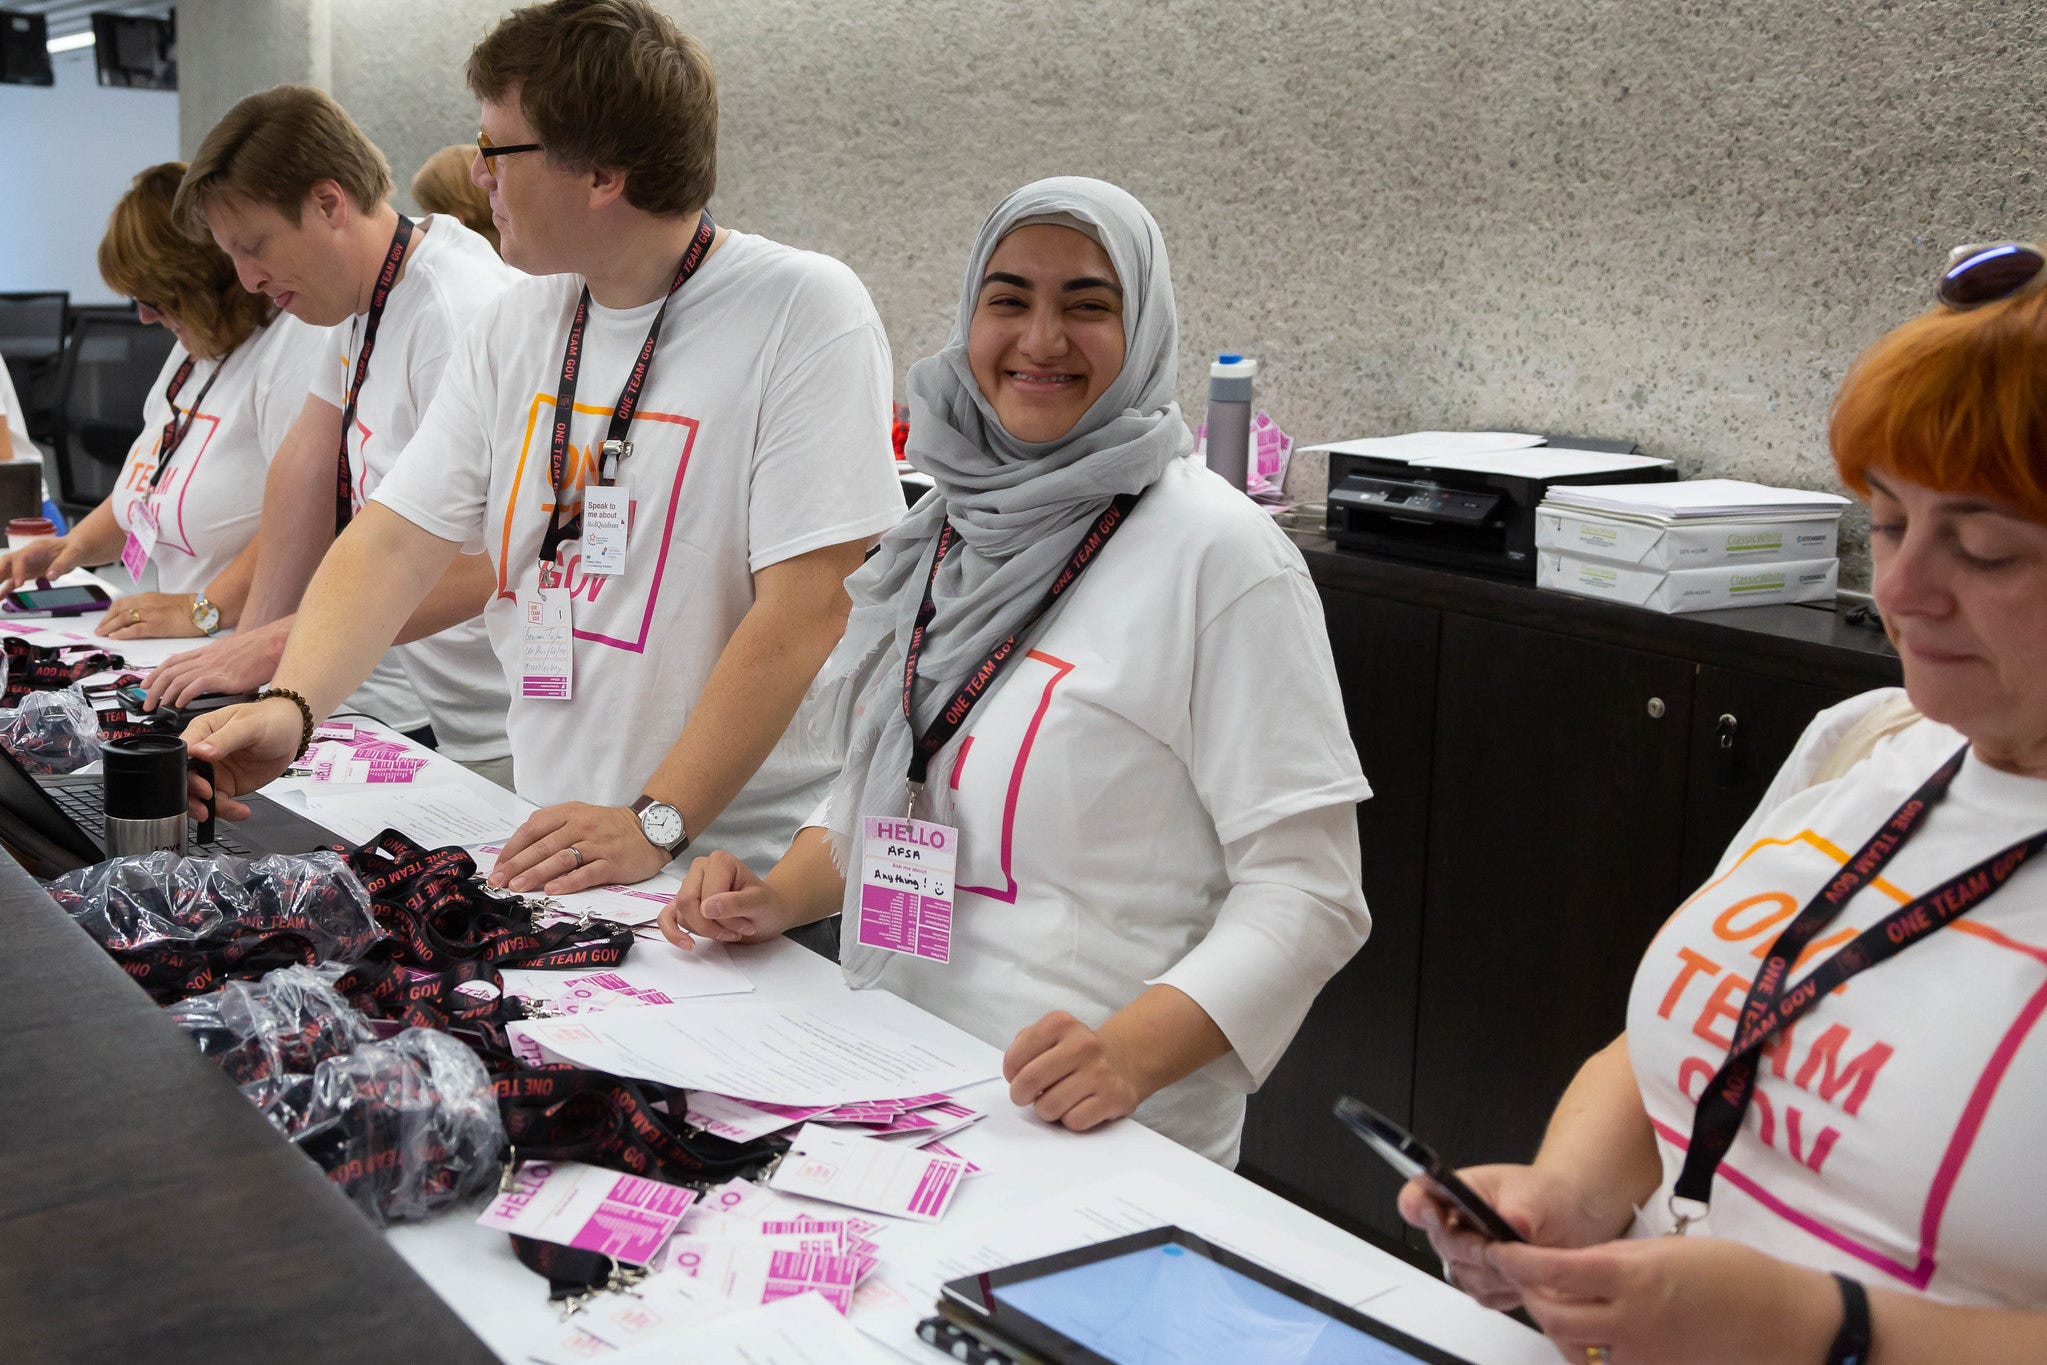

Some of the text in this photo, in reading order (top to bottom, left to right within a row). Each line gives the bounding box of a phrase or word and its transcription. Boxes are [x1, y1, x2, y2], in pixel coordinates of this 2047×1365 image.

[684, 244, 703, 273] TEAM
[699, 223, 713, 244] GOV
[374, 243, 404, 307] ONE TEAM GOV
[563, 303, 585, 381] ONE TEAM GOV
[618, 338, 655, 420] ONE TEAM GOV
[556, 422, 567, 444] ONE
[126, 462, 179, 494] TEM
[547, 440, 604, 491] ON
[552, 445, 563, 481] TEAM
[587, 501, 616, 510] Speak to
[598, 510, 617, 519] about
[938, 525, 953, 558] TEAM
[1052, 506, 1122, 596] ONE TEAM GOV
[912, 627, 924, 651] ONE
[904, 654, 916, 688] TEAM
[945, 636, 1016, 725] ONE TEAM GOV
[317, 761, 333, 782] HELLO
[877, 822, 945, 849] HELLO
[887, 845, 921, 860] AFSA
[1823, 799, 1924, 905] ONE TEAM GOV
[388, 861, 424, 884] TEAM
[892, 862, 928, 875] Ask me about
[270, 915, 307, 929] TEAM
[1886, 910, 1932, 944] ONE
[1932, 874, 1990, 920] TEAM
[414, 937, 433, 961] ONE
[550, 950, 587, 966] TEAM
[591, 948, 620, 963] GOV
[121, 962, 151, 978] ON
[1757, 956, 1786, 998] ONE
[409, 980, 442, 1000] GOV
[1780, 978, 1818, 1016] GOV
[525, 1078, 554, 1097] ONE
[610, 1087, 636, 1116] GOV
[630, 1112, 668, 1148] TEAM
[496, 1165, 553, 1219] HELLO
